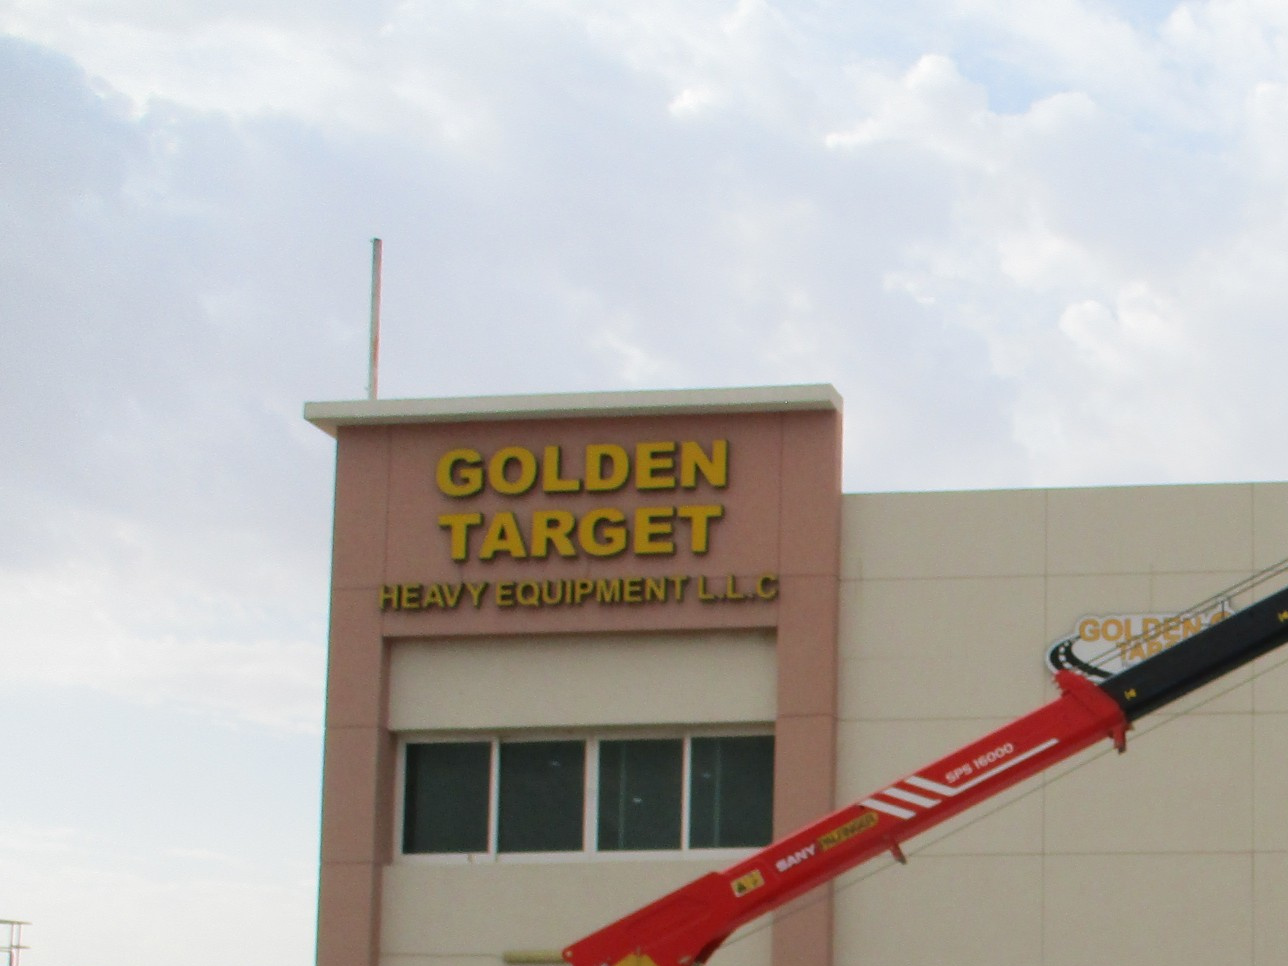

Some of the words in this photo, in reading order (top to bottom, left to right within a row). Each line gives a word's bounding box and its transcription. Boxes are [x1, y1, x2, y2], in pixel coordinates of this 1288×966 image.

[435, 438, 729, 498] GOLDEN
[438, 504, 725, 561] TARGET
[378, 581, 489, 611] HEAVY
[496, 575, 690, 608] EQUIPMENT
[1079, 615, 1202, 643] GOLDEN
[945, 762, 974, 784] SPS
[972, 742, 1015, 769] 16000
[775, 843, 817, 873] SANY
